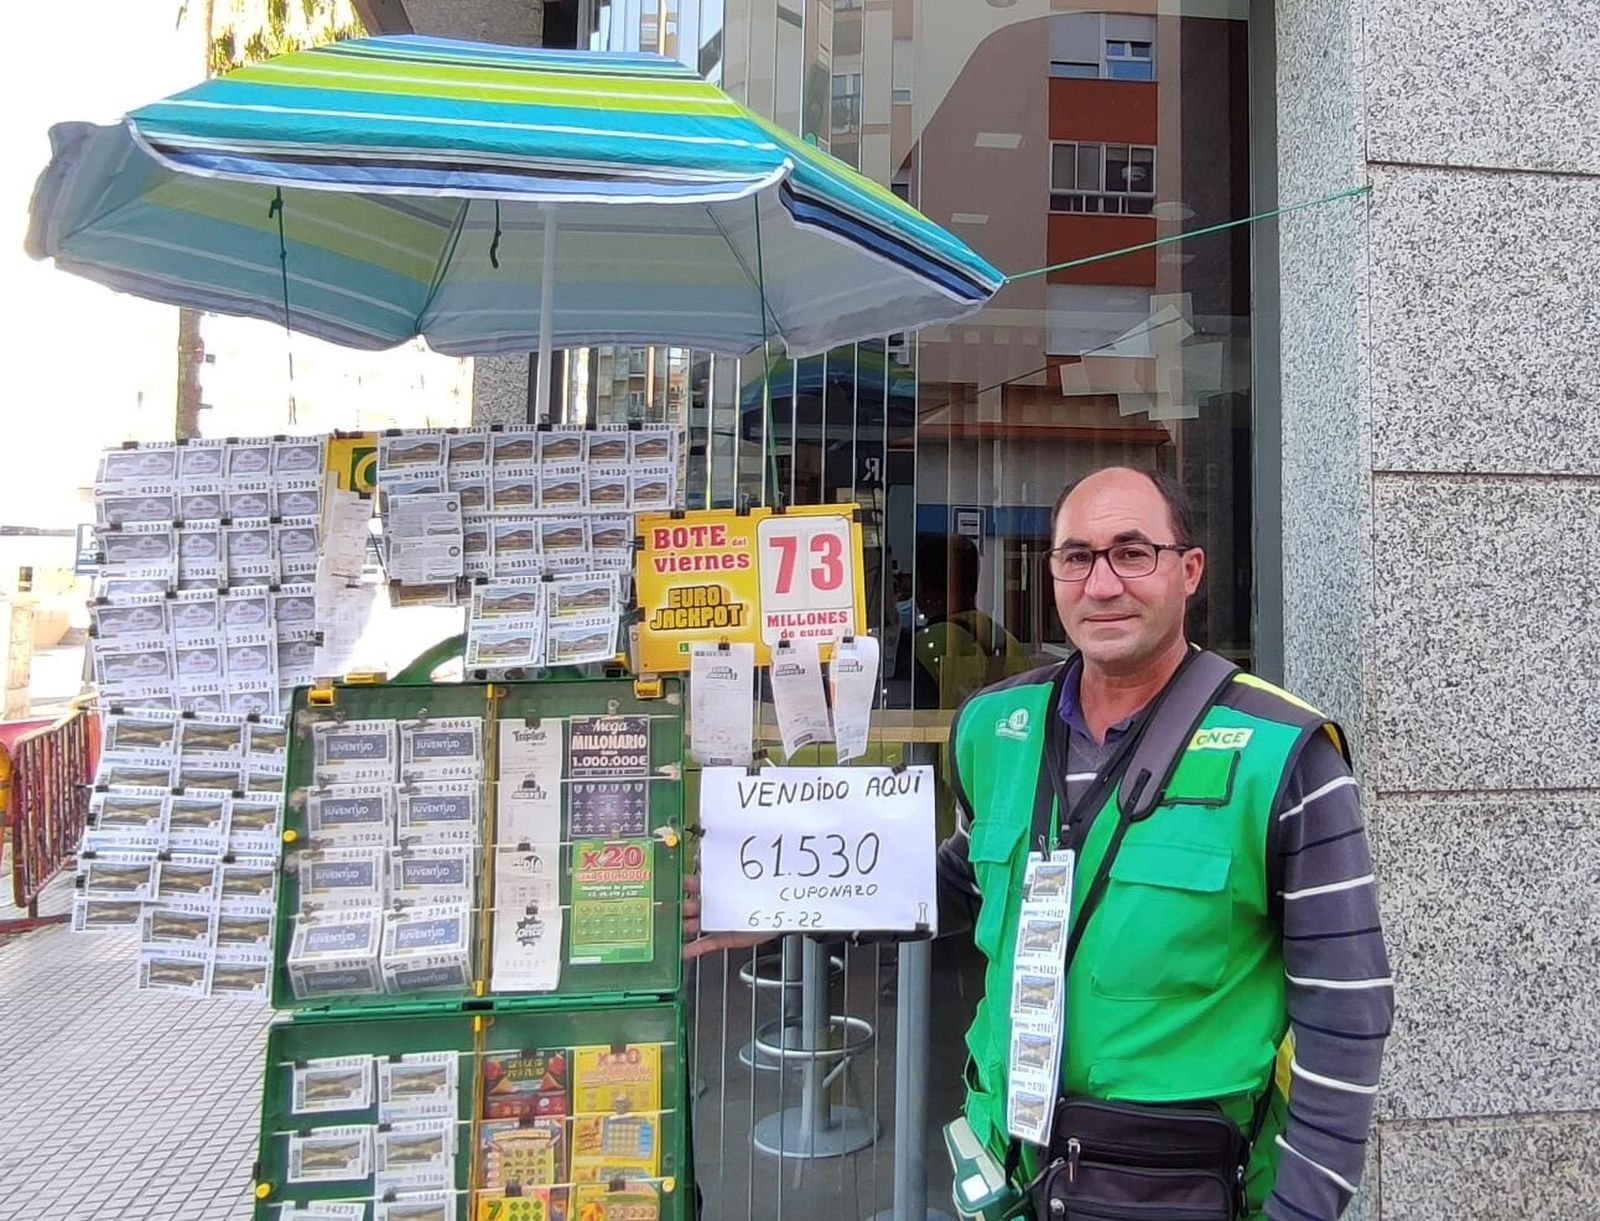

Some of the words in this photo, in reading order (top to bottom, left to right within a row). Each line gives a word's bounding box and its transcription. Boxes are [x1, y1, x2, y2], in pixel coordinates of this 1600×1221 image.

[654, 524, 726, 550] BOTE
[732, 538, 746, 546] del
[654, 552, 750, 573] viernes
[768, 533, 844, 594] 73
[669, 586, 722, 608] EURO
[650, 604, 743, 631] JACKPOT
[767, 610, 848, 628] MILLONES
[781, 629, 794, 639] de
[800, 628, 833, 639] euros
[593, 720, 629, 734] Mega
[572, 734, 646, 750] MILLONARIO
[572, 756, 647, 766] 1.000.000€
[740, 832, 880, 880] 61.530
[780, 884, 878, 902] CUPONAZO
[748, 910, 822, 928] 6-5-22
